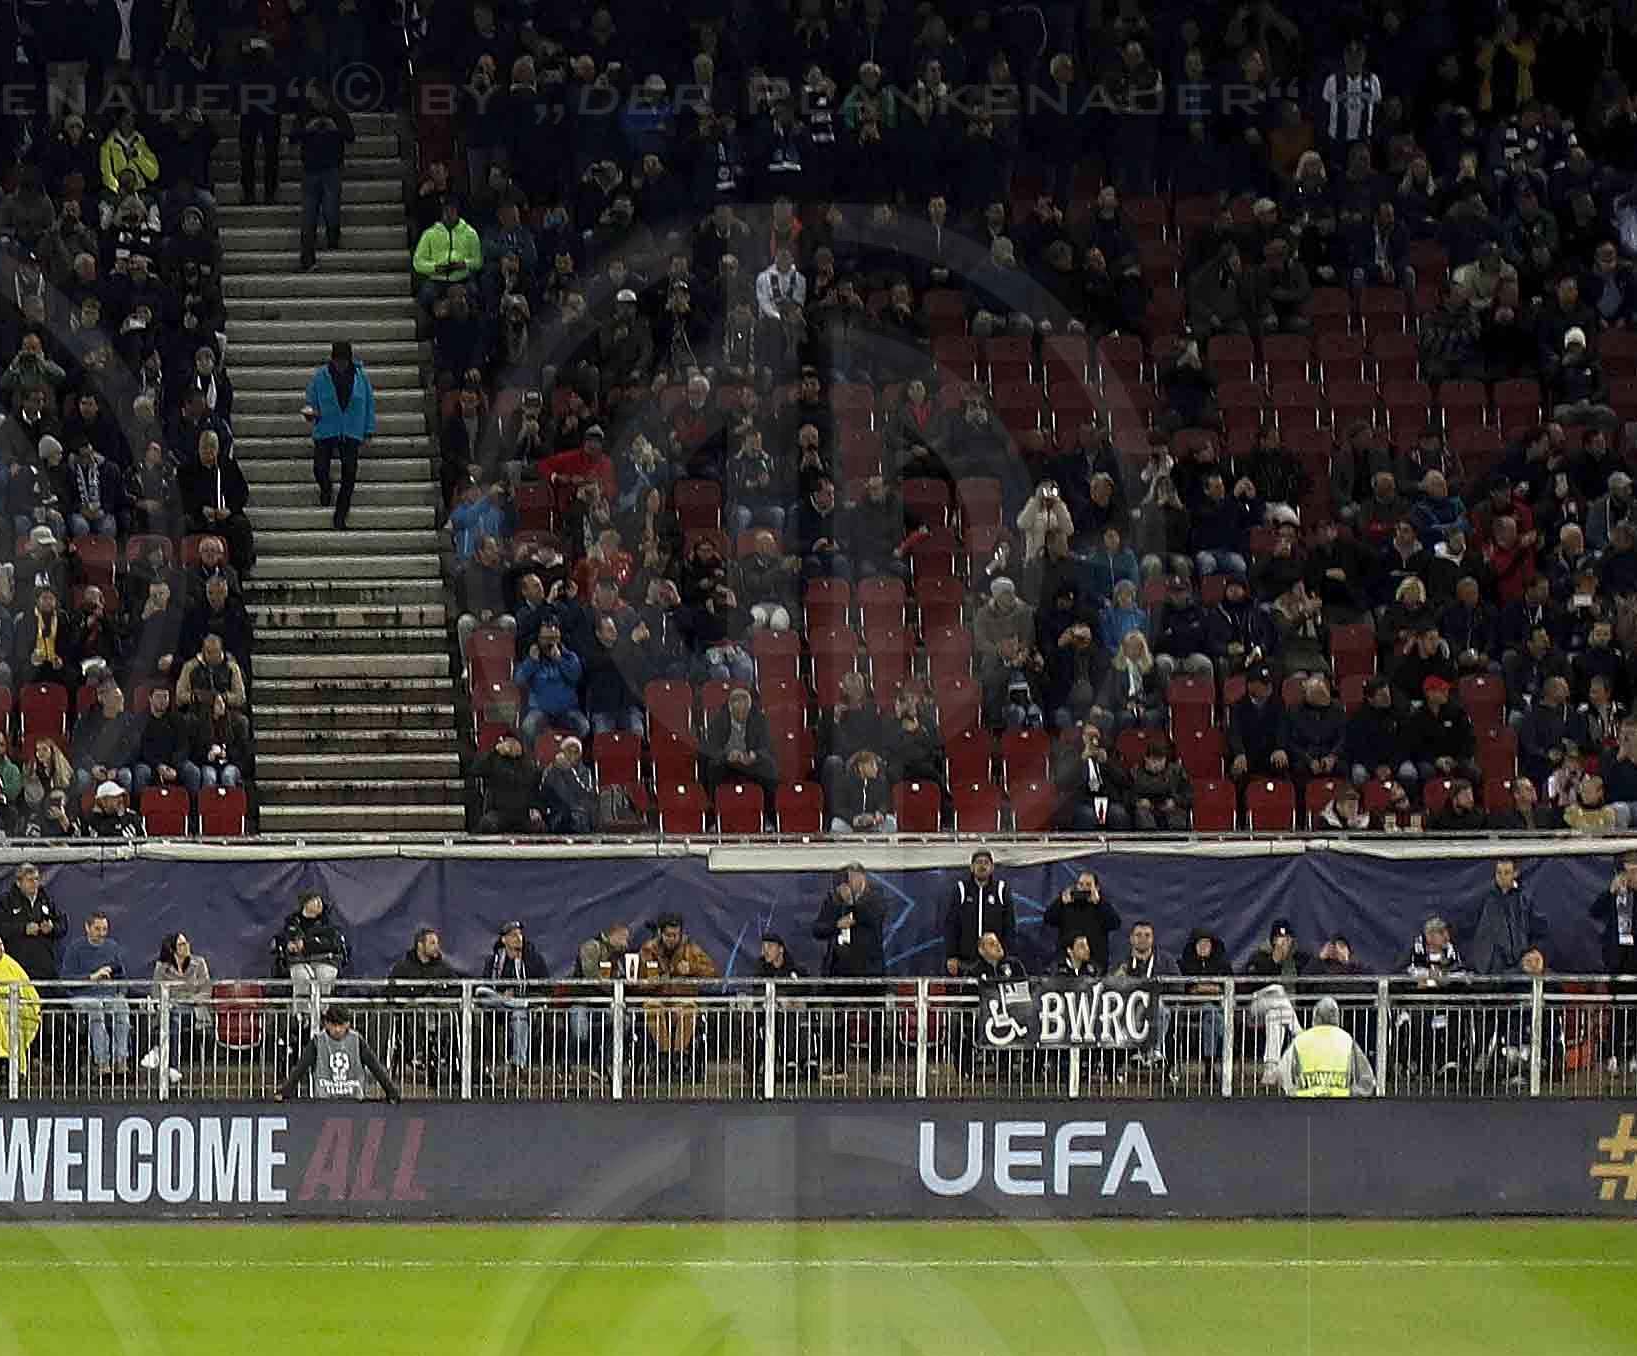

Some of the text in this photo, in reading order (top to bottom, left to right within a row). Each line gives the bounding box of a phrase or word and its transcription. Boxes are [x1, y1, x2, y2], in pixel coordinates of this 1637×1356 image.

[1041, 985, 1151, 1047] BWRC
[298, 1116, 428, 1203] ALL
[917, 1120, 1169, 1197] UEFA
